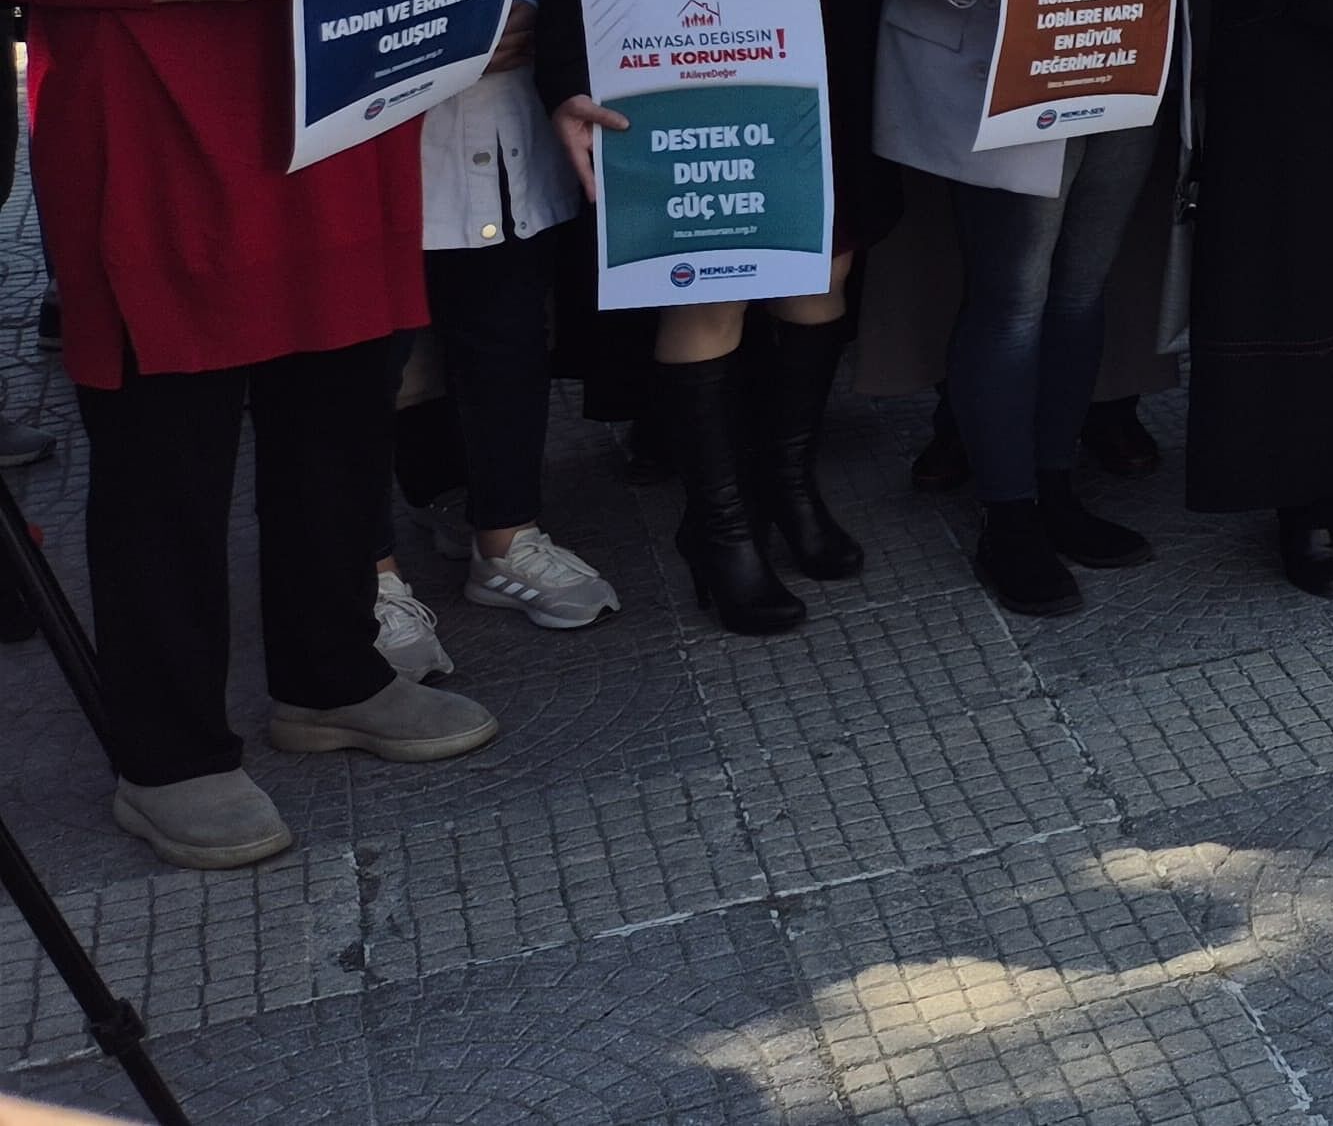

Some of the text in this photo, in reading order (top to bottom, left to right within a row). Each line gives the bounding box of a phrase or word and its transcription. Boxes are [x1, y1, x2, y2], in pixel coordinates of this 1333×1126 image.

[321, 8, 384, 42] KADIN
[387, 1, 411, 26] VE
[1036, 3, 1144, 30] LOBİLERE KARŞI
[378, 16, 448, 54] OLUŞUR
[621, 34, 695, 51] ANAYASA
[1054, 27, 1122, 51] EN BÜYÜK
[619, 53, 661, 70] AİLE
[1030, 48, 1137, 76] DEĞERİMİZ AİLE
[651, 123, 775, 153] DESTEK OL
[673, 158, 755, 185] DUYUR
[667, 191, 765, 221] GÜÇ VER
[700, 263, 758, 275] MEMUR-SEN
